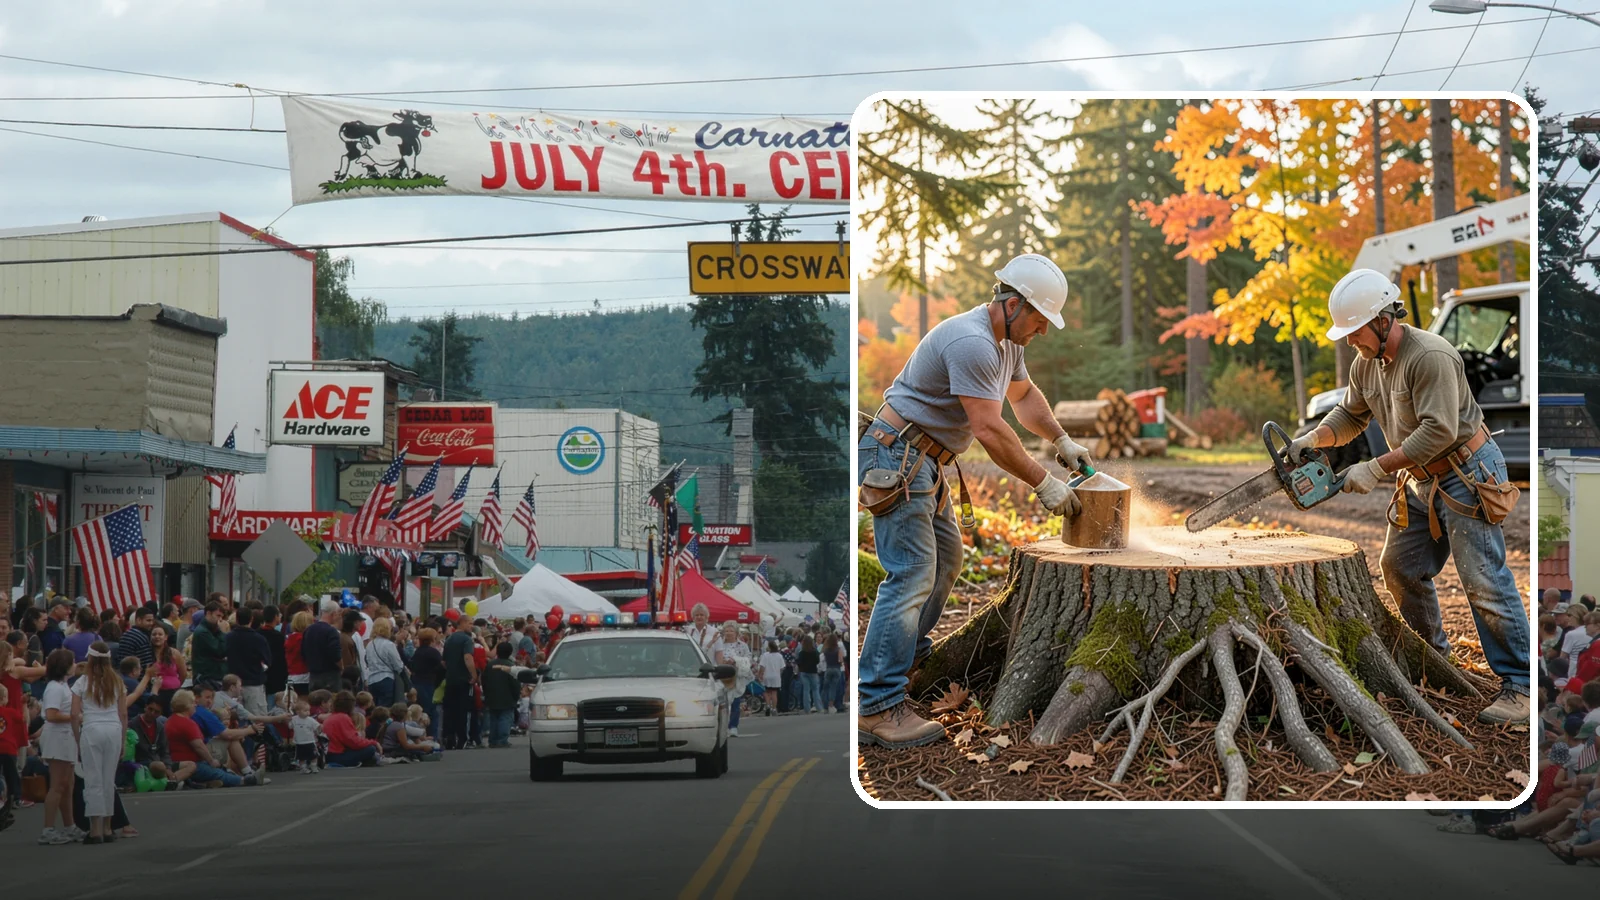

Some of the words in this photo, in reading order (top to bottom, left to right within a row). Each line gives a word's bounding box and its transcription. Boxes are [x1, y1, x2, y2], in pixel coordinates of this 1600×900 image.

[481, 140, 605, 192] JULY
[632, 150, 746, 197] 4th.
[697, 254, 850, 280] CROSSWA
[282, 380, 374, 420] ACE
[405, 409, 453, 422] CEDAR
[460, 409, 485, 421] LOG
[283, 421, 371, 436] Hardware
[353, 467, 386, 483] Simpl
[83, 484, 93, 494] St.
[96, 484, 124, 495] Vincent
[126, 486, 136, 495] de
[137, 486, 155, 495] Paul
[688, 526, 741, 535] CRNATION
[699, 535, 730, 543] GLASS
